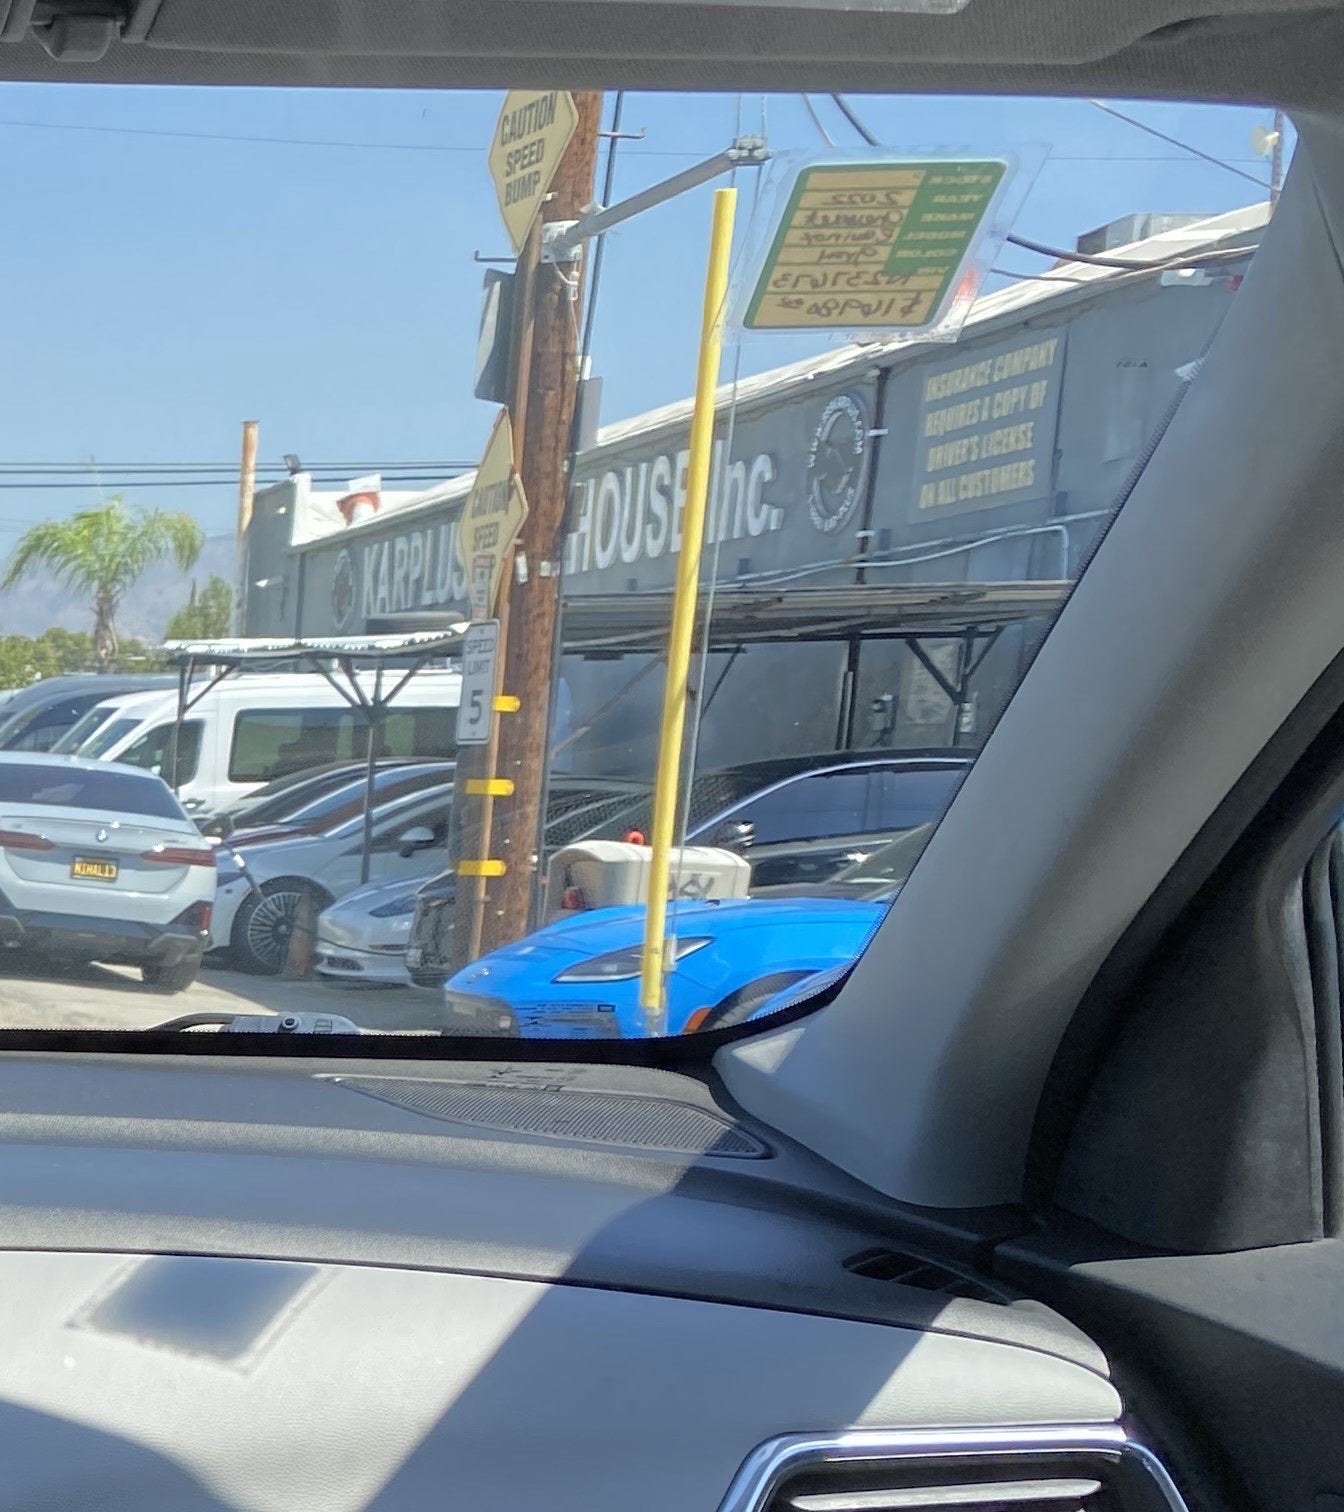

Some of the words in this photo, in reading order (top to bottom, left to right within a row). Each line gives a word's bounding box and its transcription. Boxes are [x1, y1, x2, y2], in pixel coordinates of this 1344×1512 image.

[501, 91, 558, 146] CAUTION
[506, 138, 545, 177] SPEED
[505, 170, 541, 207] BUMP
[925, 358, 993, 401] INSURANCE
[993, 338, 1058, 382] COMPANY
[924, 398, 981, 437] REQUIRES
[981, 396, 991, 421] A
[992, 385, 1028, 419] COPY
[1029, 380, 1048, 409] OF
[927, 435, 980, 472] DRIVER'S
[981, 422, 1034, 459] LICENSE
[937, 478, 957, 505] ALL
[958, 459, 1036, 500] CUSTOMERS
[466, 638, 494, 653] SPEED
[468, 659, 490, 675] LIMIT
[469, 690, 484, 725] 5
